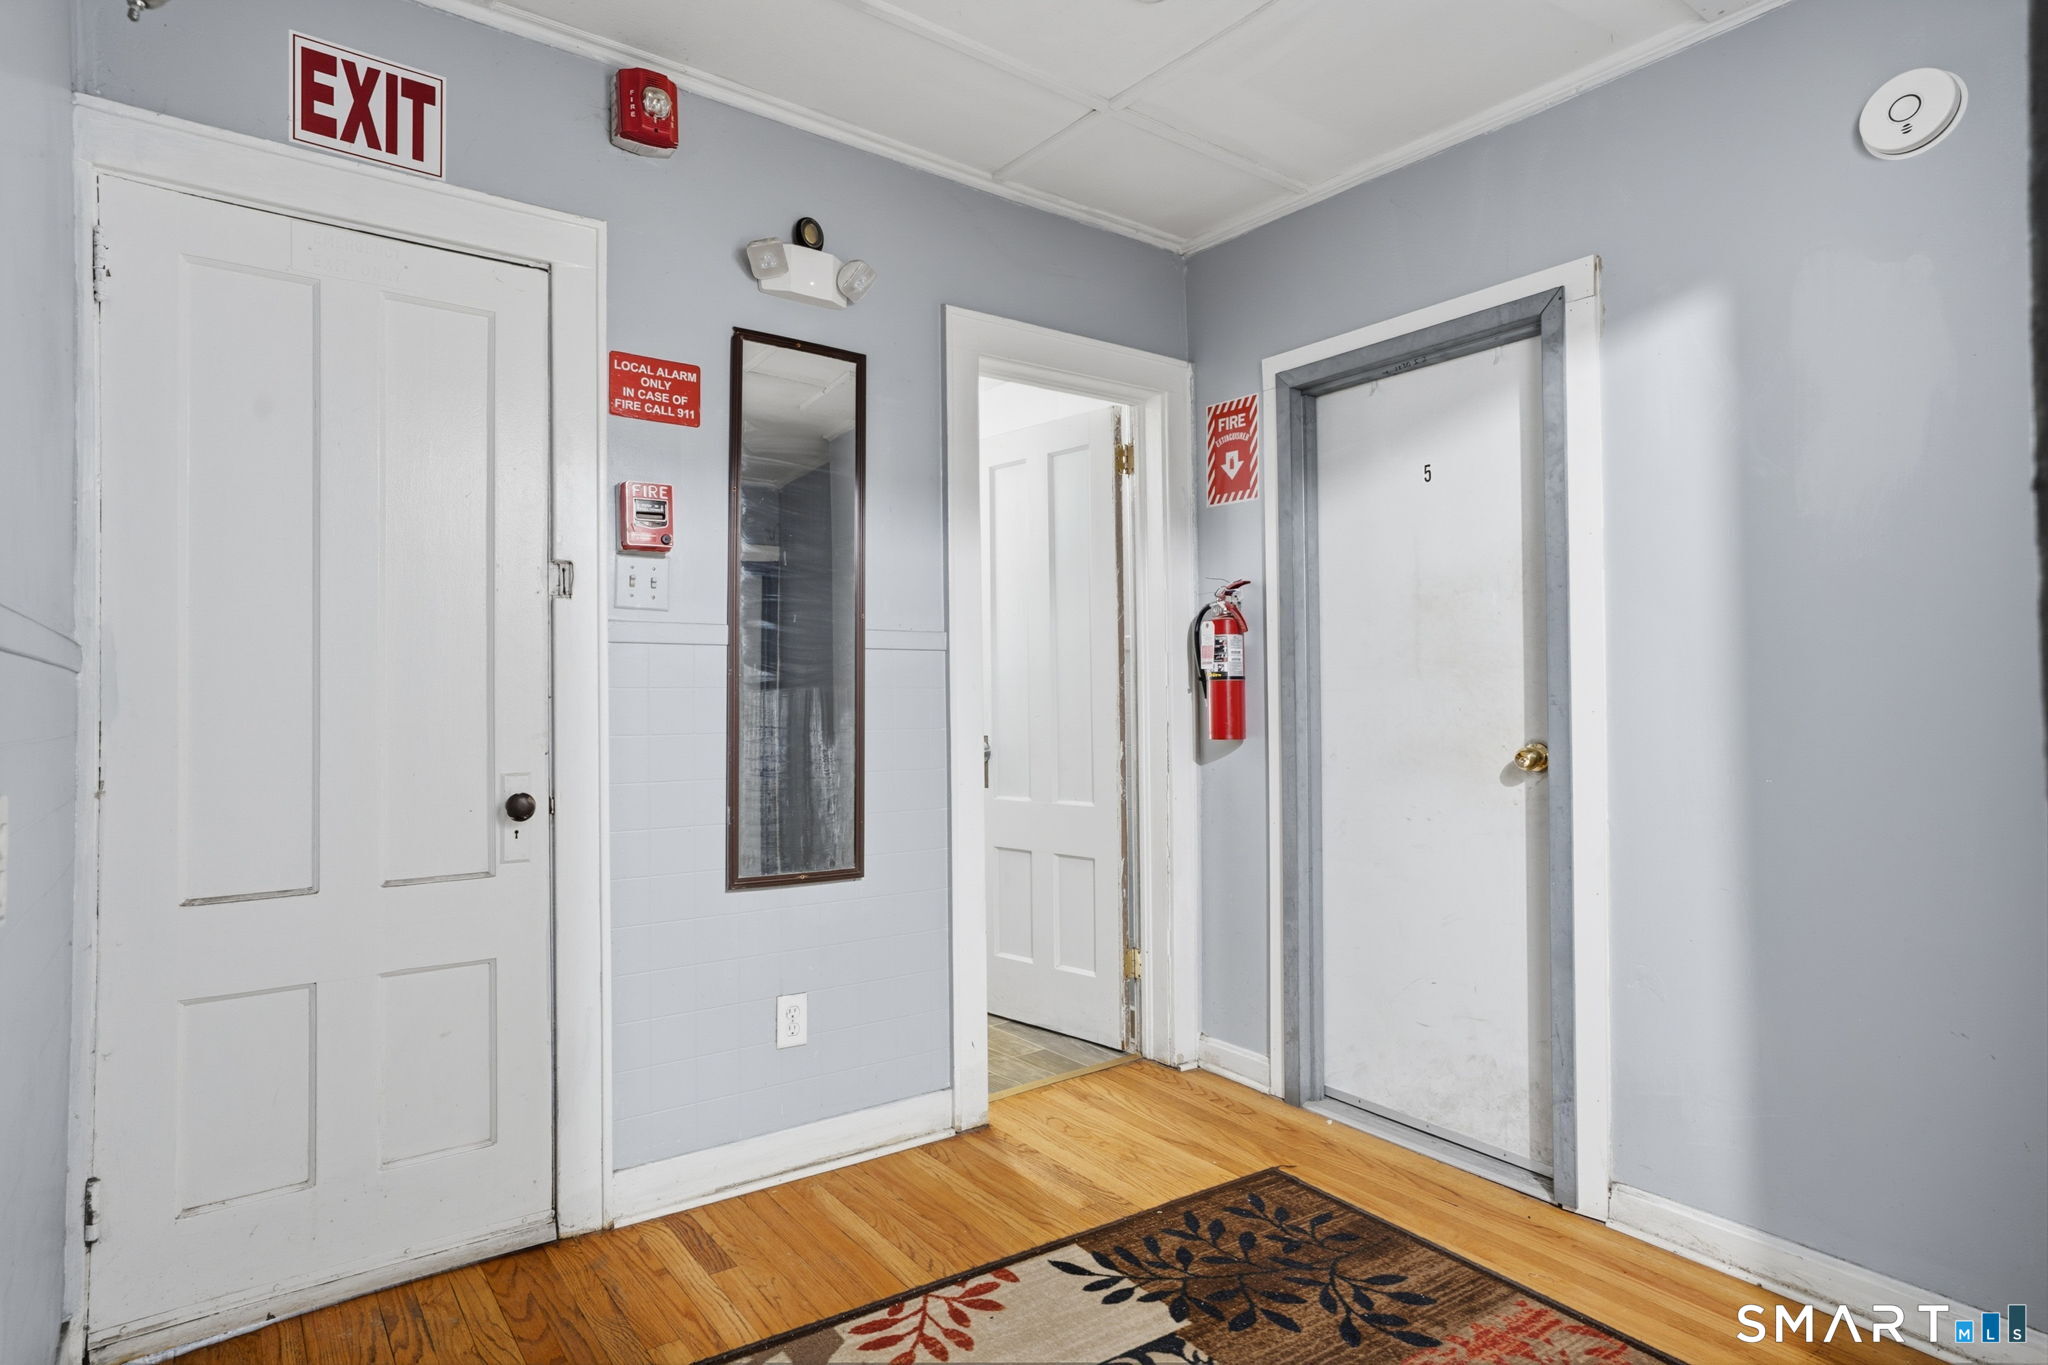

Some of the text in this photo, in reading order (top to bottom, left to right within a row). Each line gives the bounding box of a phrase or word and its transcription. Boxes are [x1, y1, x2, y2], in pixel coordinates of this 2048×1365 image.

[301, 46, 436, 162] EXIT
[614, 359, 697, 383] LOCAL ALARM
[640, 377, 672, 391] ONLY
[622, 386, 688, 406] IN CASE OF
[614, 398, 695, 420] FIRE CALL 911
[1218, 413, 1246, 432] FIRE
[1424, 463, 1432, 482] 5
[632, 484, 669, 499] FIRE
